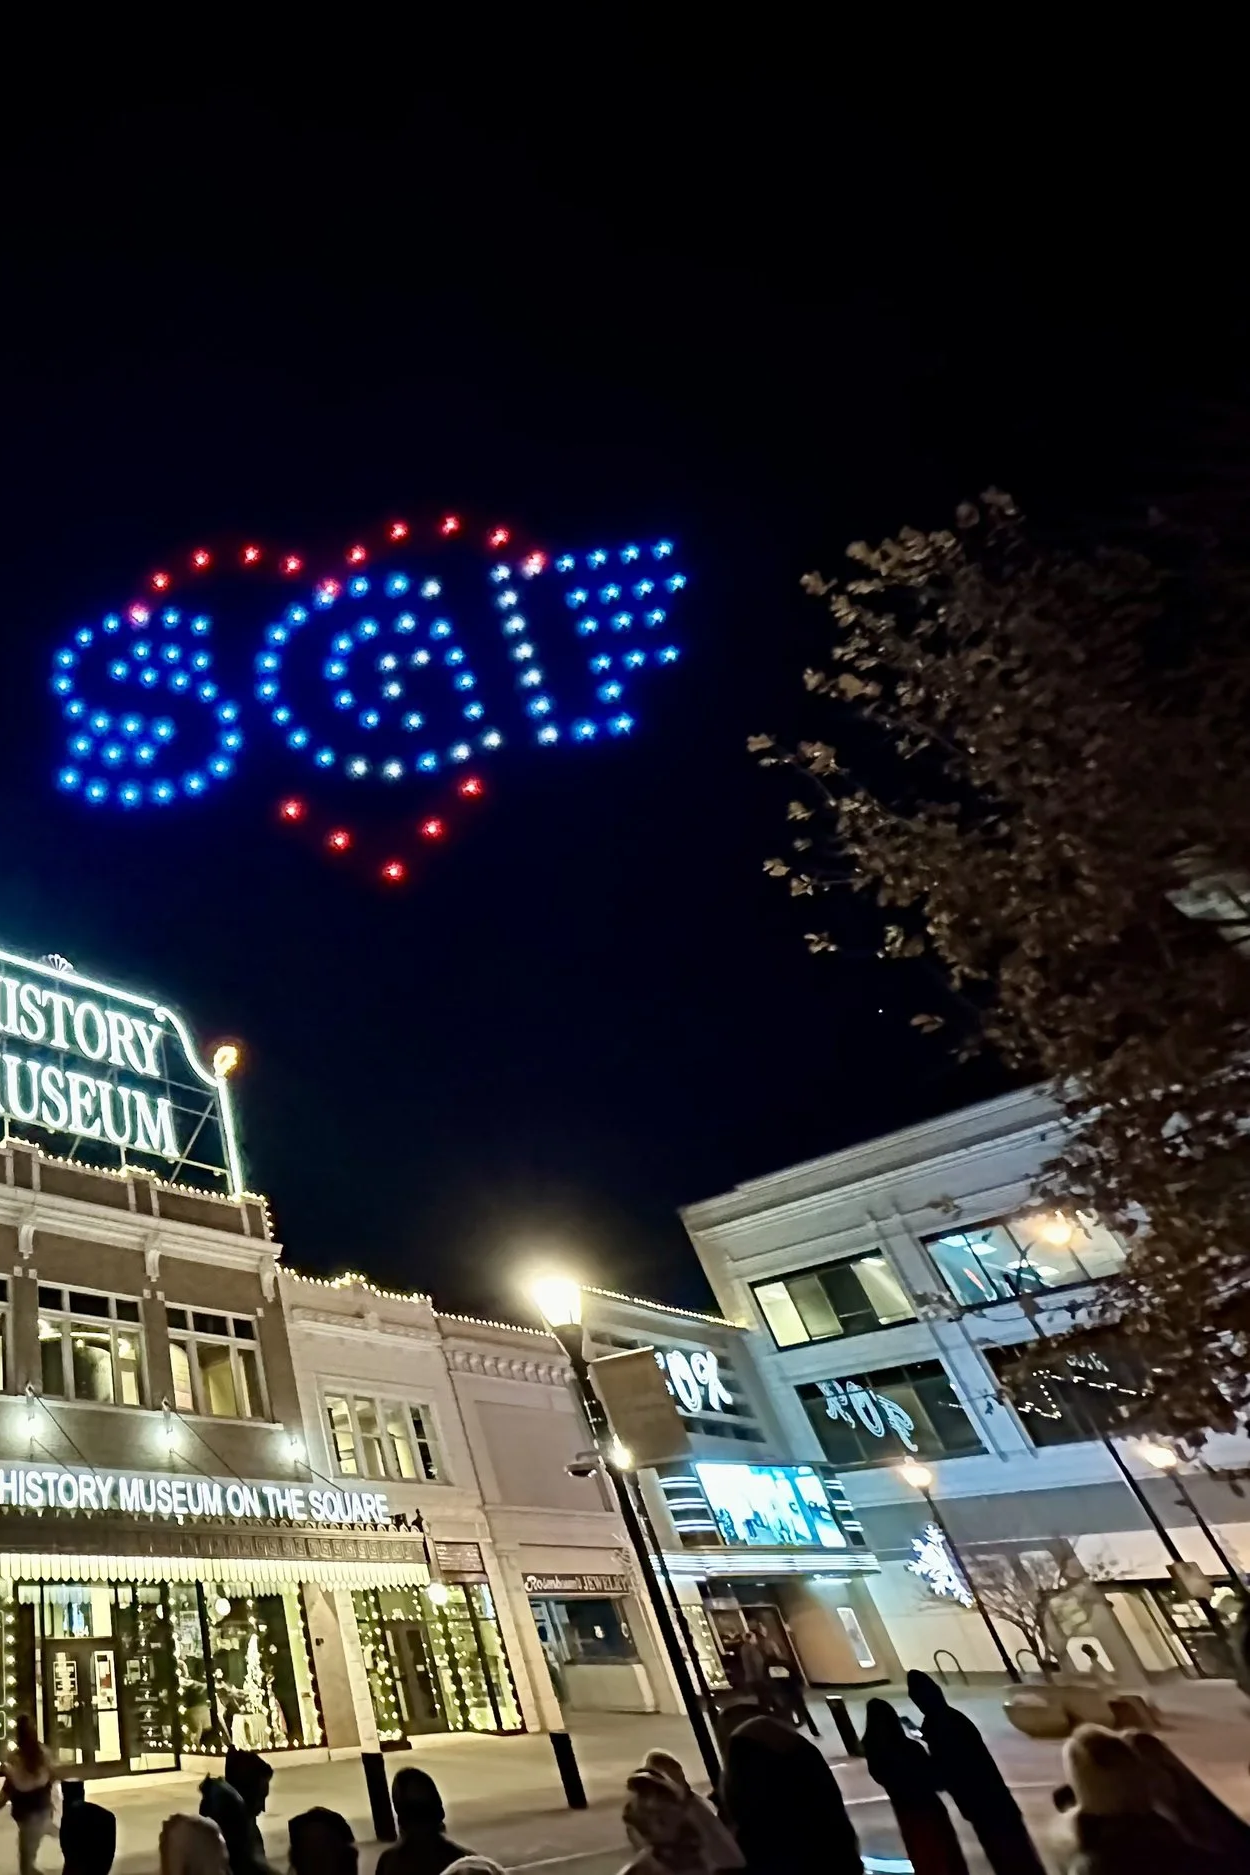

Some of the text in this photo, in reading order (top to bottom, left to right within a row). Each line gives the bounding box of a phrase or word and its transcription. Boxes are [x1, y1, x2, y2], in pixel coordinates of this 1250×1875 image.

[52, 536, 688, 806] SGF
[118, 1477, 222, 1516] MUSEUM
[226, 1485, 260, 1518] ON
[264, 1487, 306, 1520] THE
[308, 1490, 391, 1524] SQUARE
[582, 1576, 628, 1591] JEWELRY
